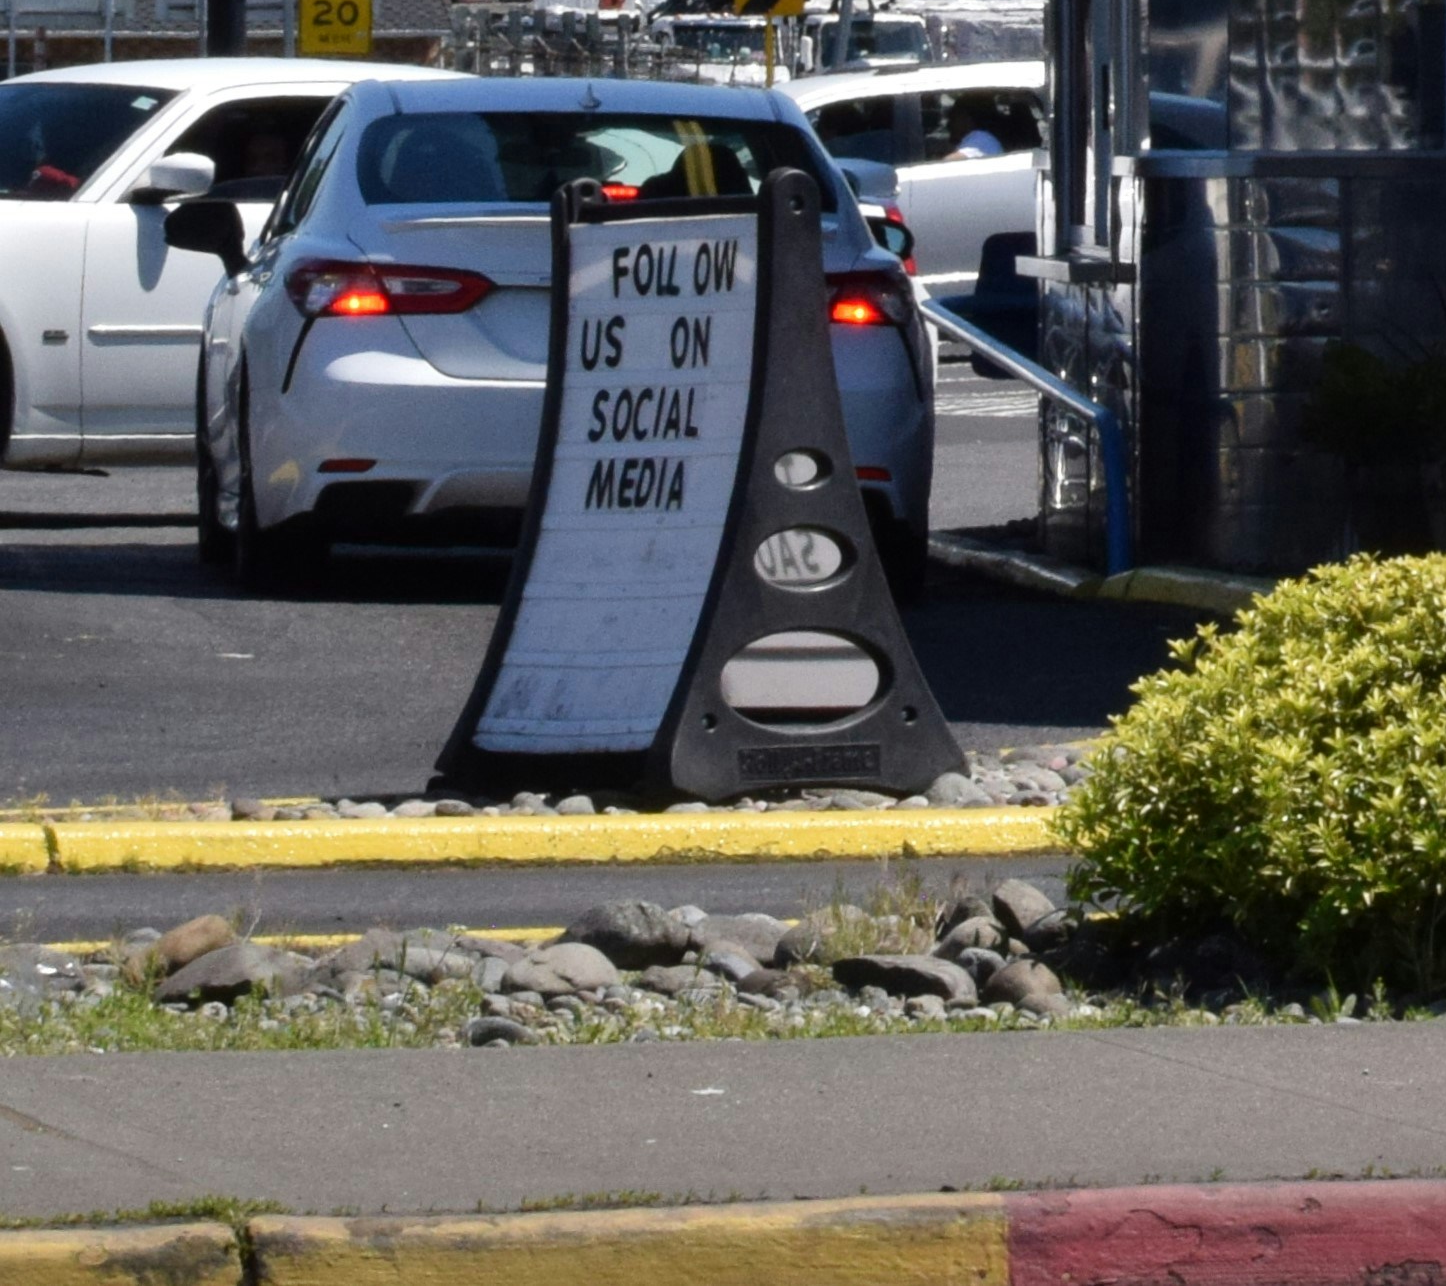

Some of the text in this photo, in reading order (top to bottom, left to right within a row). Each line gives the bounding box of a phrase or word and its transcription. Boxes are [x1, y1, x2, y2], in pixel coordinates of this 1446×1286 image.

[312, 0, 359, 26] 20
[580, 315, 712, 371] US ON
[587, 386, 699, 443] SOCIAL
[585, 457, 685, 511] MEDIA
